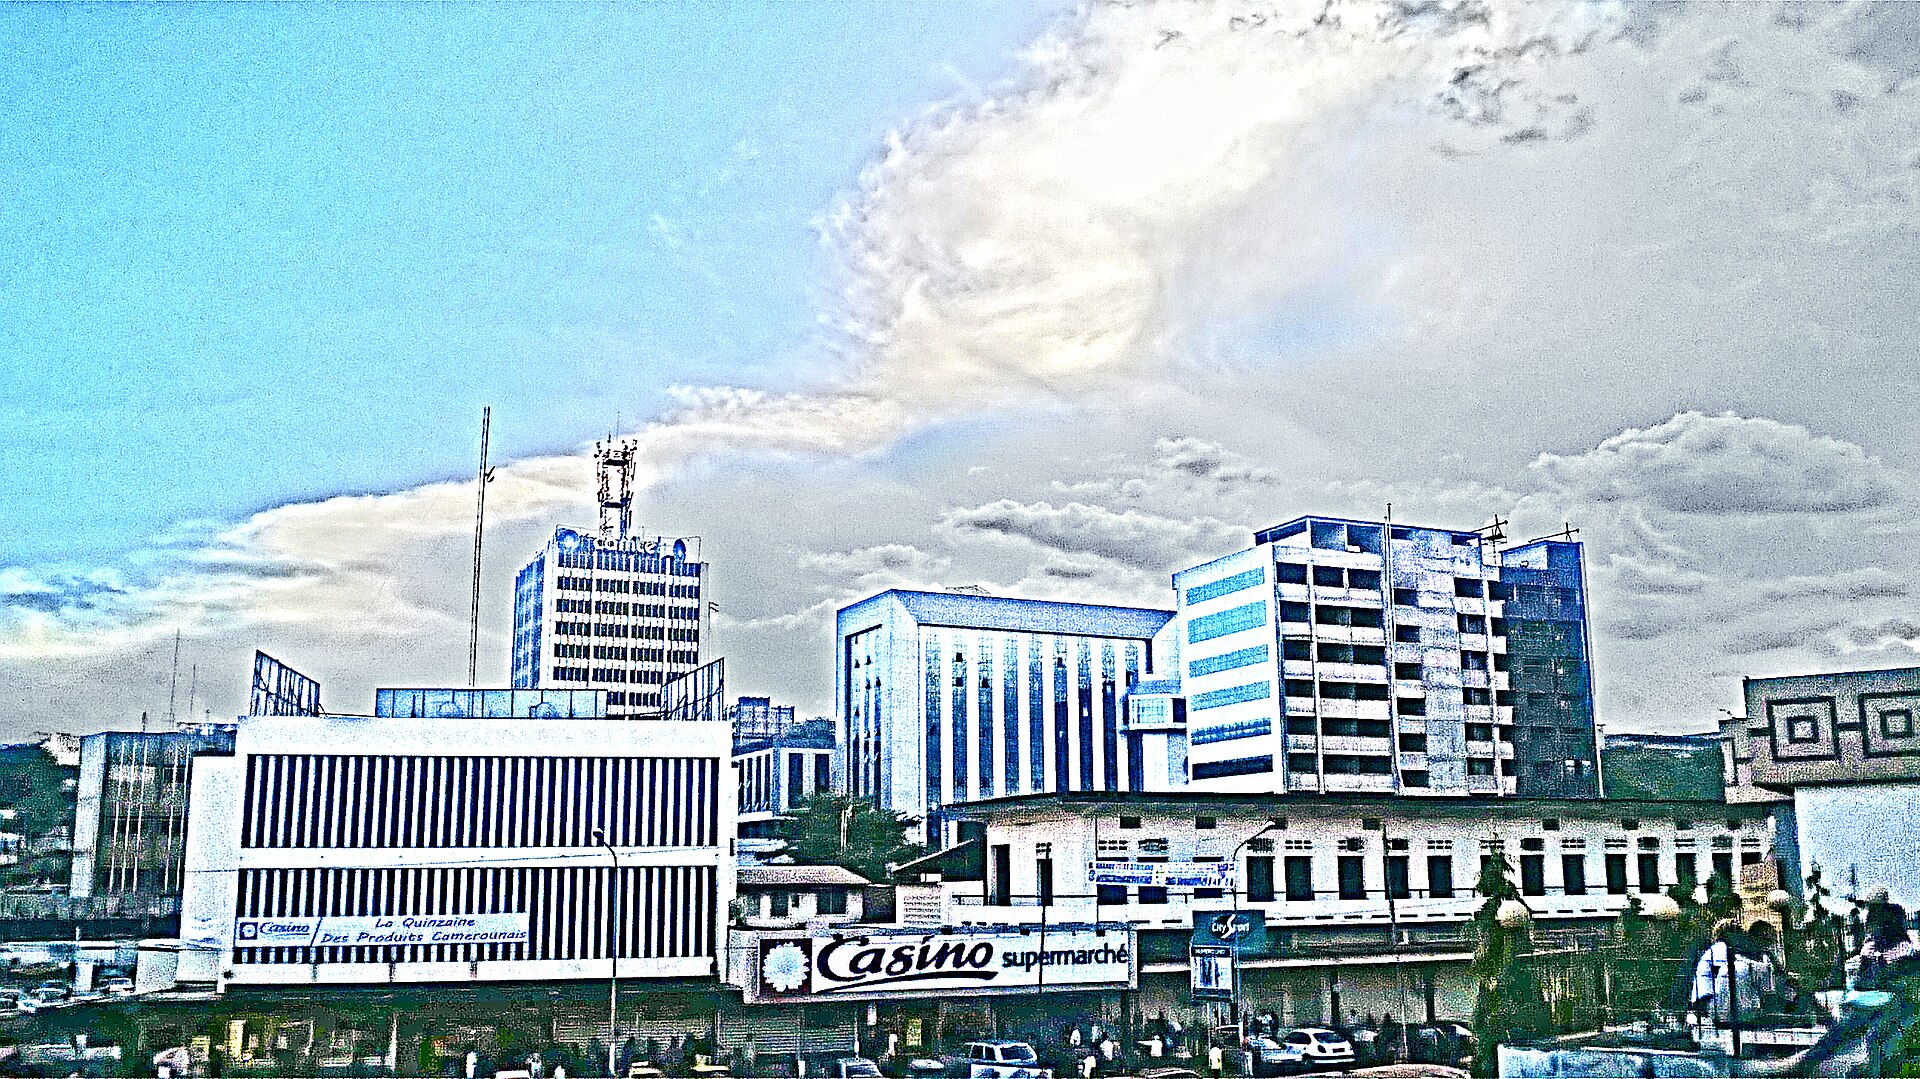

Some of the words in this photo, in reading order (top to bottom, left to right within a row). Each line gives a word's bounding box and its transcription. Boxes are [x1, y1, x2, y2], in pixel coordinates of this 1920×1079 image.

[260, 921, 310, 936] Casino
[375, 918, 394, 928] La
[402, 917, 476, 929] Quinzaine
[320, 933, 350, 943] Des
[356, 931, 424, 942] Produits
[431, 930, 528, 941] Camerounais
[817, 935, 996, 985] Casino
[1003, 943, 1129, 970] supermarché
